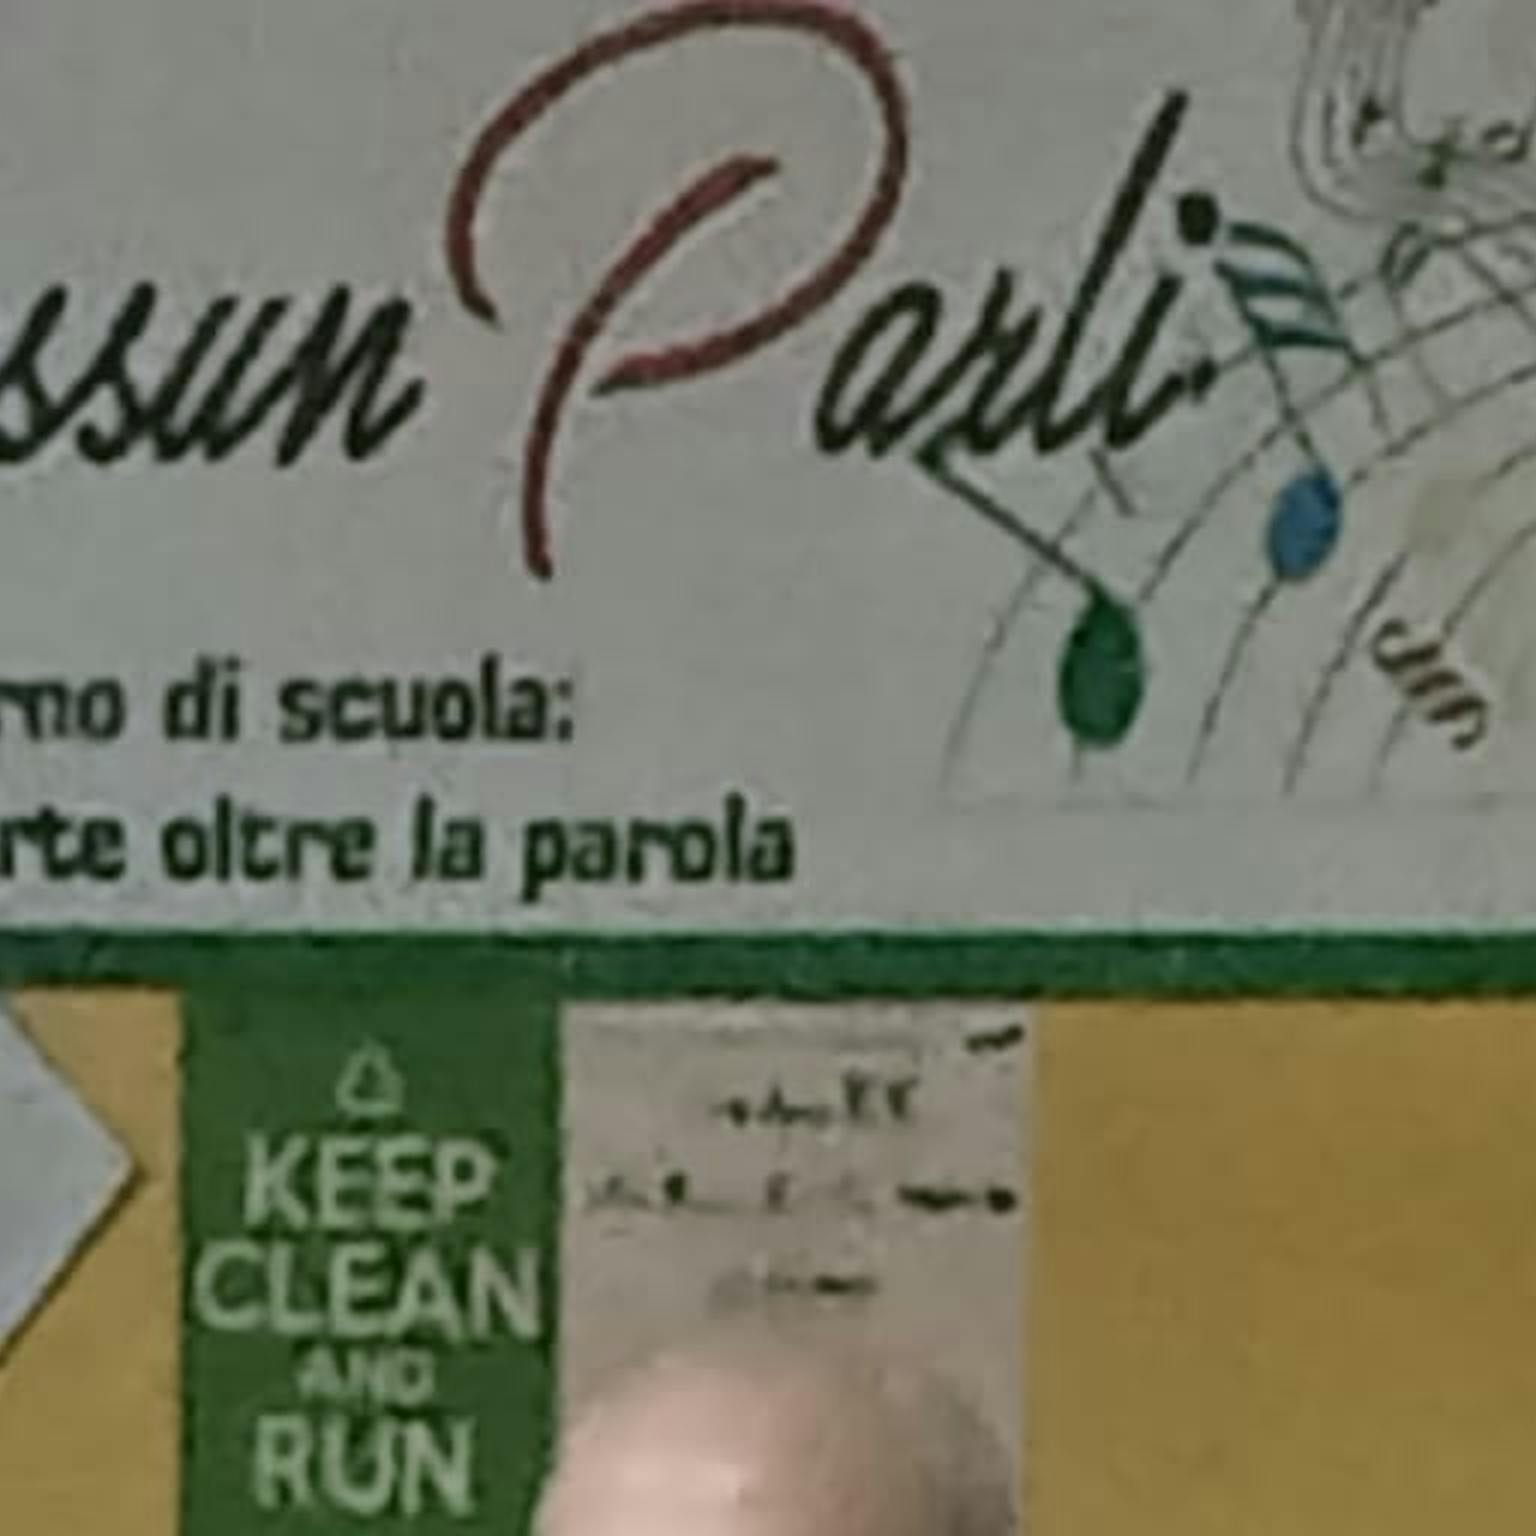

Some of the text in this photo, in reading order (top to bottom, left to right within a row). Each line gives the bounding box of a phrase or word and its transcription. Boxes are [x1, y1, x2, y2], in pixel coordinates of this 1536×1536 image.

[164, 655, 241, 740] di
[277, 651, 575, 741] scuola:
[162, 795, 376, 881] oltre
[412, 793, 485, 881] la
[523, 791, 796, 902] parola
[244, 1133, 497, 1230] KEEP
[194, 1240, 541, 1339] CLEAN
[297, 1345, 436, 1405] AND
[256, 1415, 476, 1517] RUN
